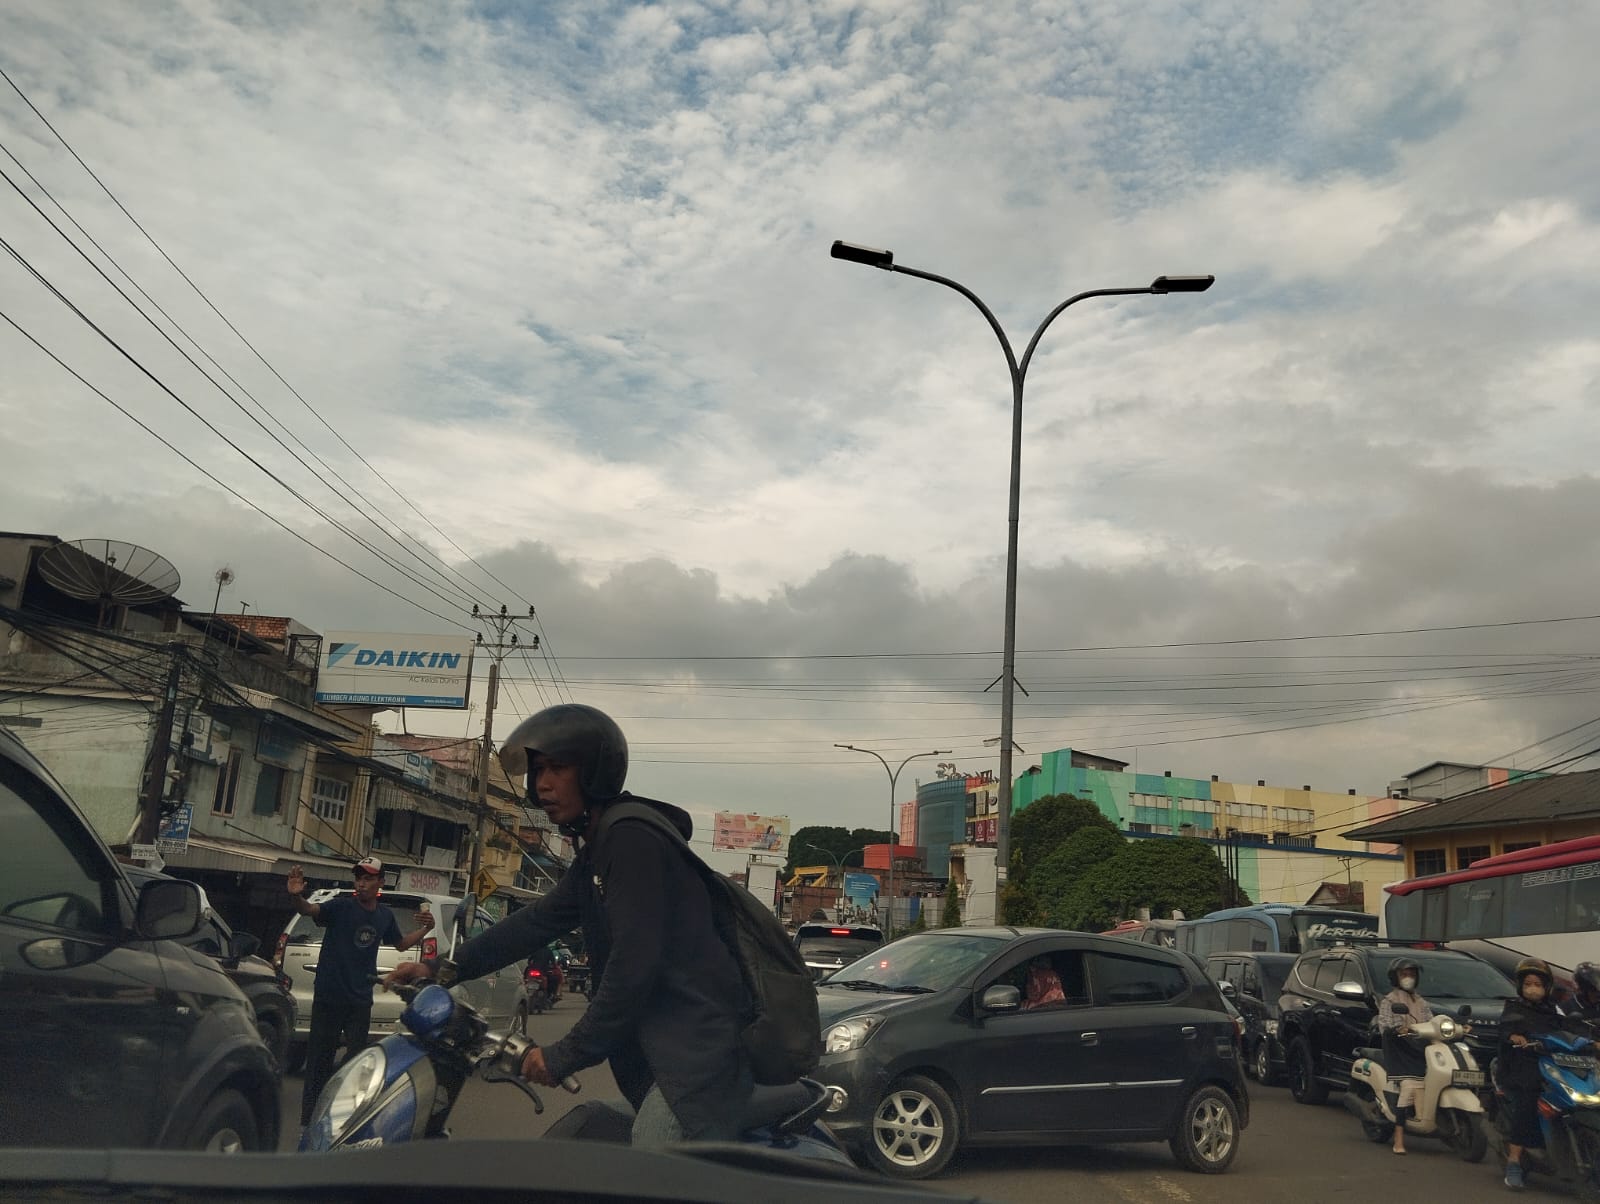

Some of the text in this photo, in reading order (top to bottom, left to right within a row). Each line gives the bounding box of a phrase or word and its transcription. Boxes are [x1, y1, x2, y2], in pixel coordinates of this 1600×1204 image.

[354, 649, 461, 669] DAIKIN
[348, 694, 370, 703] AGUNG
[370, 696, 406, 704] ELEKTRONIK
[410, 871, 441, 890] SHARP
